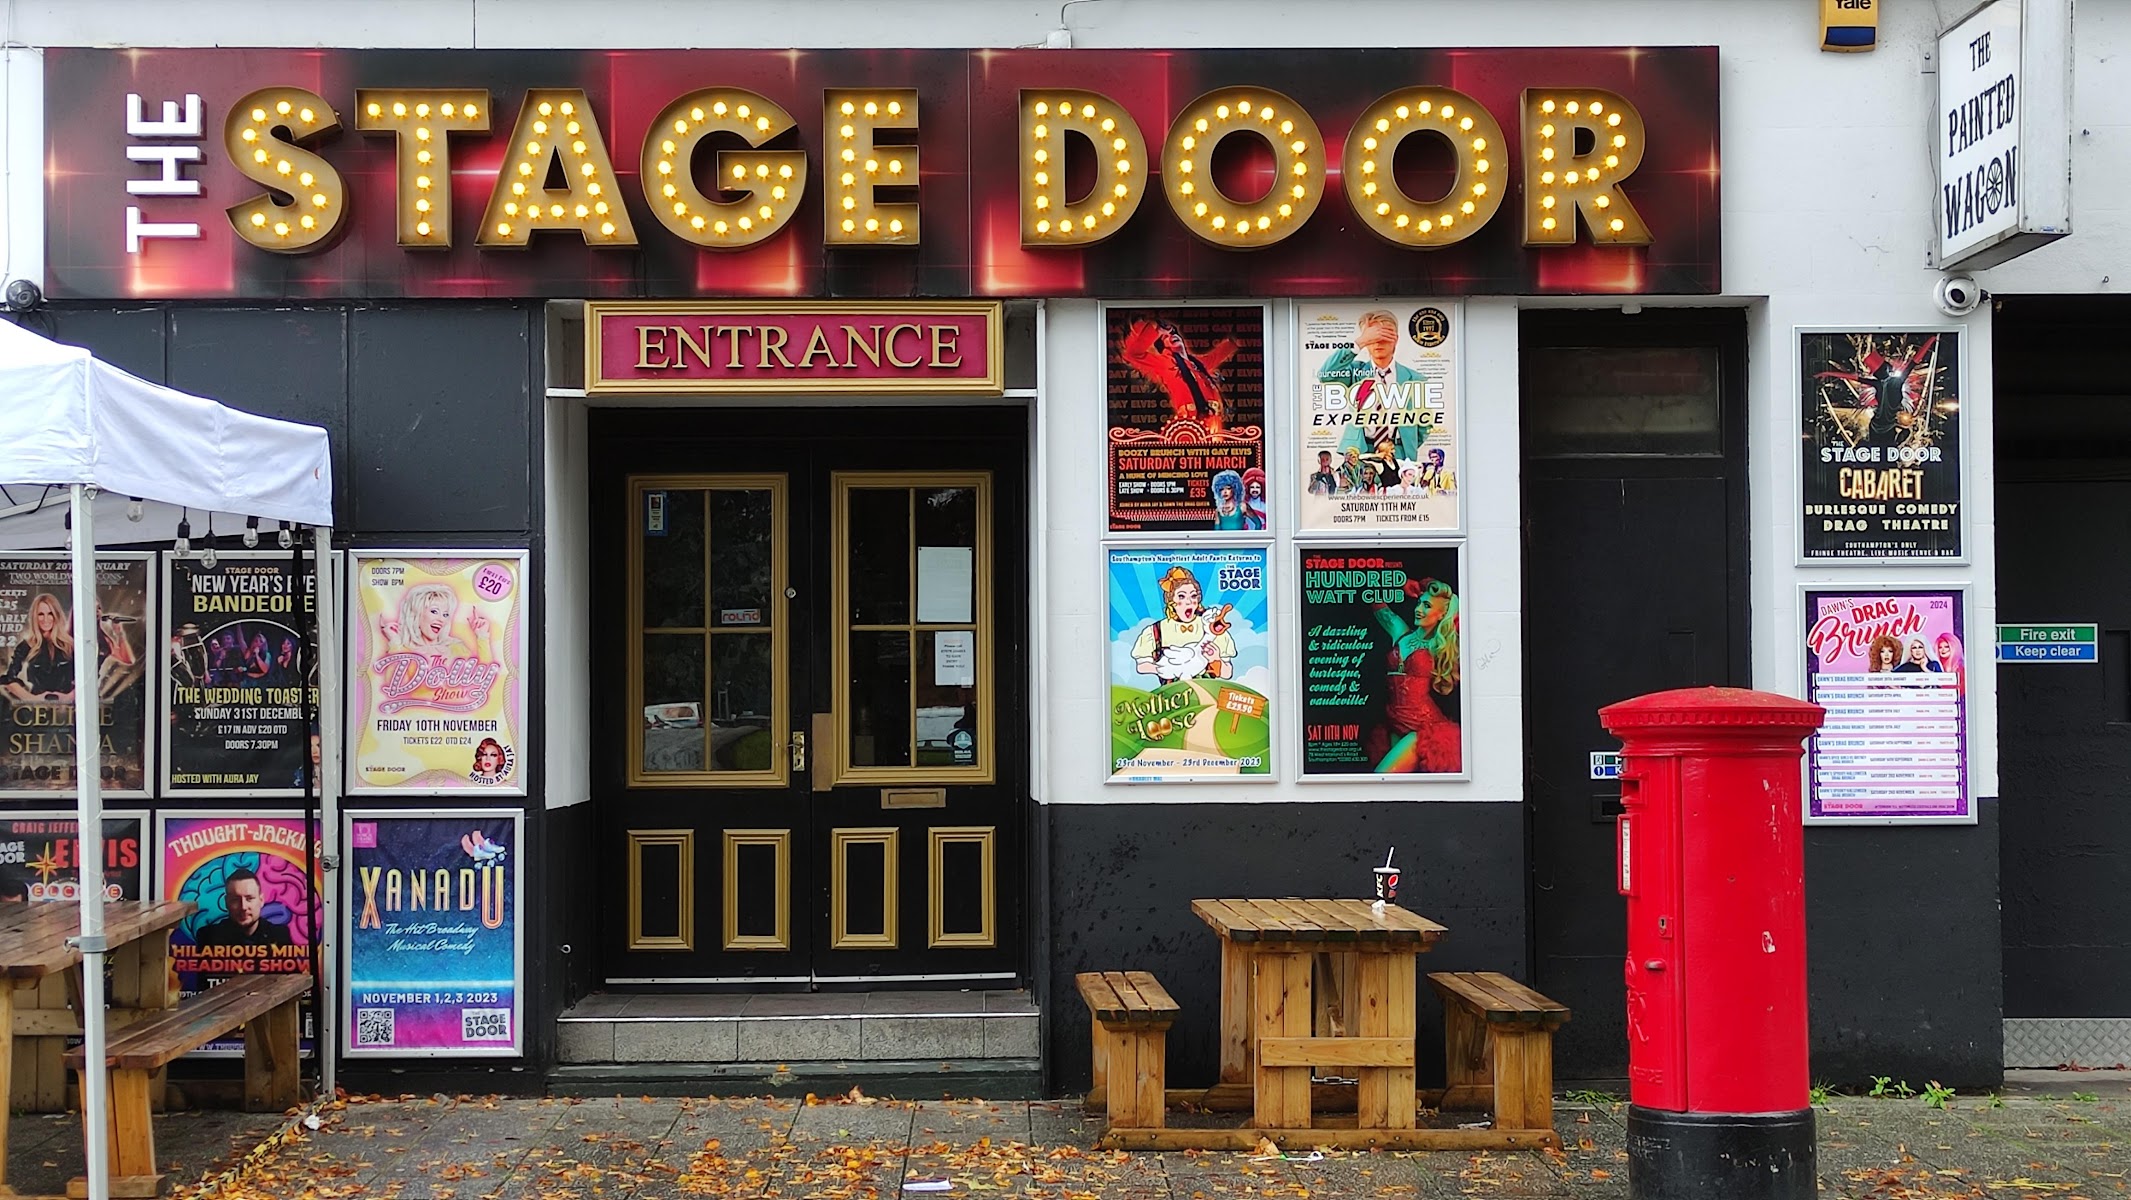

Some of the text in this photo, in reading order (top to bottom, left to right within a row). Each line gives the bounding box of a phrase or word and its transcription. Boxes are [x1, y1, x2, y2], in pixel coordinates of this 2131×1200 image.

[1969, 31, 1992, 71] THE
[1948, 74, 2016, 157] PAINTED
[125, 92, 201, 254] THE
[222, 84, 1656, 252] STAGE DOOR
[1944, 146, 2017, 239] WAGON
[634, 323, 963, 370] ENTRANCE
[1305, 342, 1330, 350] STAGE
[1313, 369, 1351, 379] aurence
[1313, 384, 1323, 411] THE
[1324, 380, 1445, 413] BOWIE
[1312, 411, 1445, 427] EXPERIENCE
[1118, 447, 1253, 457] BOOZY BRUNCH WITH GAY ELVIS
[1820, 446, 1942, 462] STAGE DOOR
[1118, 456, 1247, 470] SATURDAY 9TH MARCH
[1187, 479, 1210, 487] TICKETS
[1839, 466, 1925, 501] CABARET
[1189, 487, 1207, 498] £35
[1341, 502, 1417, 512] SATURDAY 11TH MAY
[1805, 503, 1958, 516] BURLESQUE COMEDY
[1333, 514, 1430, 523] DOORS 7PM TICKETS FROM £15
[1823, 518, 1949, 532] DRAG THEATRE
[1901, 541, 1917, 549] ONLY
[0, 562, 131, 571] SATURDAY NUARY
[1305, 558, 1385, 569] STAGE DOOR
[9, 572, 31, 580] TWO
[225, 567, 280, 575] STAGE DOOR
[1219, 568, 1260, 579] STAGE
[192, 574, 283, 594] NEW YEAR'S
[372, 578, 389, 586] SHOW
[478, 576, 502, 595] £20
[1219, 578, 1261, 590] DOOR
[1305, 570, 1407, 588] HUNDRED
[1305, 589, 1405, 604] WATT CLUB
[1820, 598, 1855, 617] DAWN'S
[1851, 598, 1948, 625] DRAG 2024
[0, 614, 28, 624] ARLY
[1307, 625, 1368, 640] A dazzling
[1808, 604, 1927, 664] Brunch
[2020, 628, 2076, 640] Fire exit
[1308, 639, 1374, 651] & ridiculous
[2015, 645, 2081, 659] Keep clear
[430, 654, 447, 667] The
[1308, 652, 1366, 668] evening of
[373, 653, 502, 705] Dolly
[1308, 667, 1361, 682] burlesque,
[433, 686, 470, 702] Show
[1308, 681, 1361, 695] comedy &
[177, 687, 263, 704] THE WEDDING
[1228, 691, 1255, 705] Tickets
[1309, 694, 1369, 706] vaudeville!
[194, 707, 258, 720] SUNDAY 31ST
[1115, 687, 1195, 726] Mother
[13, 705, 115, 727] CELIE
[217, 724, 288, 735] £17 IN ADV £20 OTD
[377, 719, 497, 732] FRIDAY 10TH NOVEMBER
[1307, 724, 1360, 741] SAT 11TH NOV
[224, 740, 279, 750] DOORS 7.30PM
[403, 736, 472, 745] TICKETS £22 OTD £24
[1116, 757, 1261, 768] 23rd November 23rd December 2023
[171, 774, 260, 784] HOSTED WITH AURA JAY
[12, 822, 79, 834] CRAIG JEFFE
[0, 842, 25, 853] AGE
[169, 823, 321, 859] THOUGHT-JACKIG
[1375, 873, 1384, 898] KFC
[359, 865, 505, 930] XANADU
[385, 922, 480, 939] The Hit Broadway
[172, 943, 268, 958] HILARIOUS
[386, 938, 477, 956] Musical Comedy
[176, 959, 255, 972] READING
[362, 992, 499, 1005] NOVEMBER 1,2,3 2023
[465, 1014, 506, 1027] STAGE
[466, 1025, 508, 1039] DOOR
